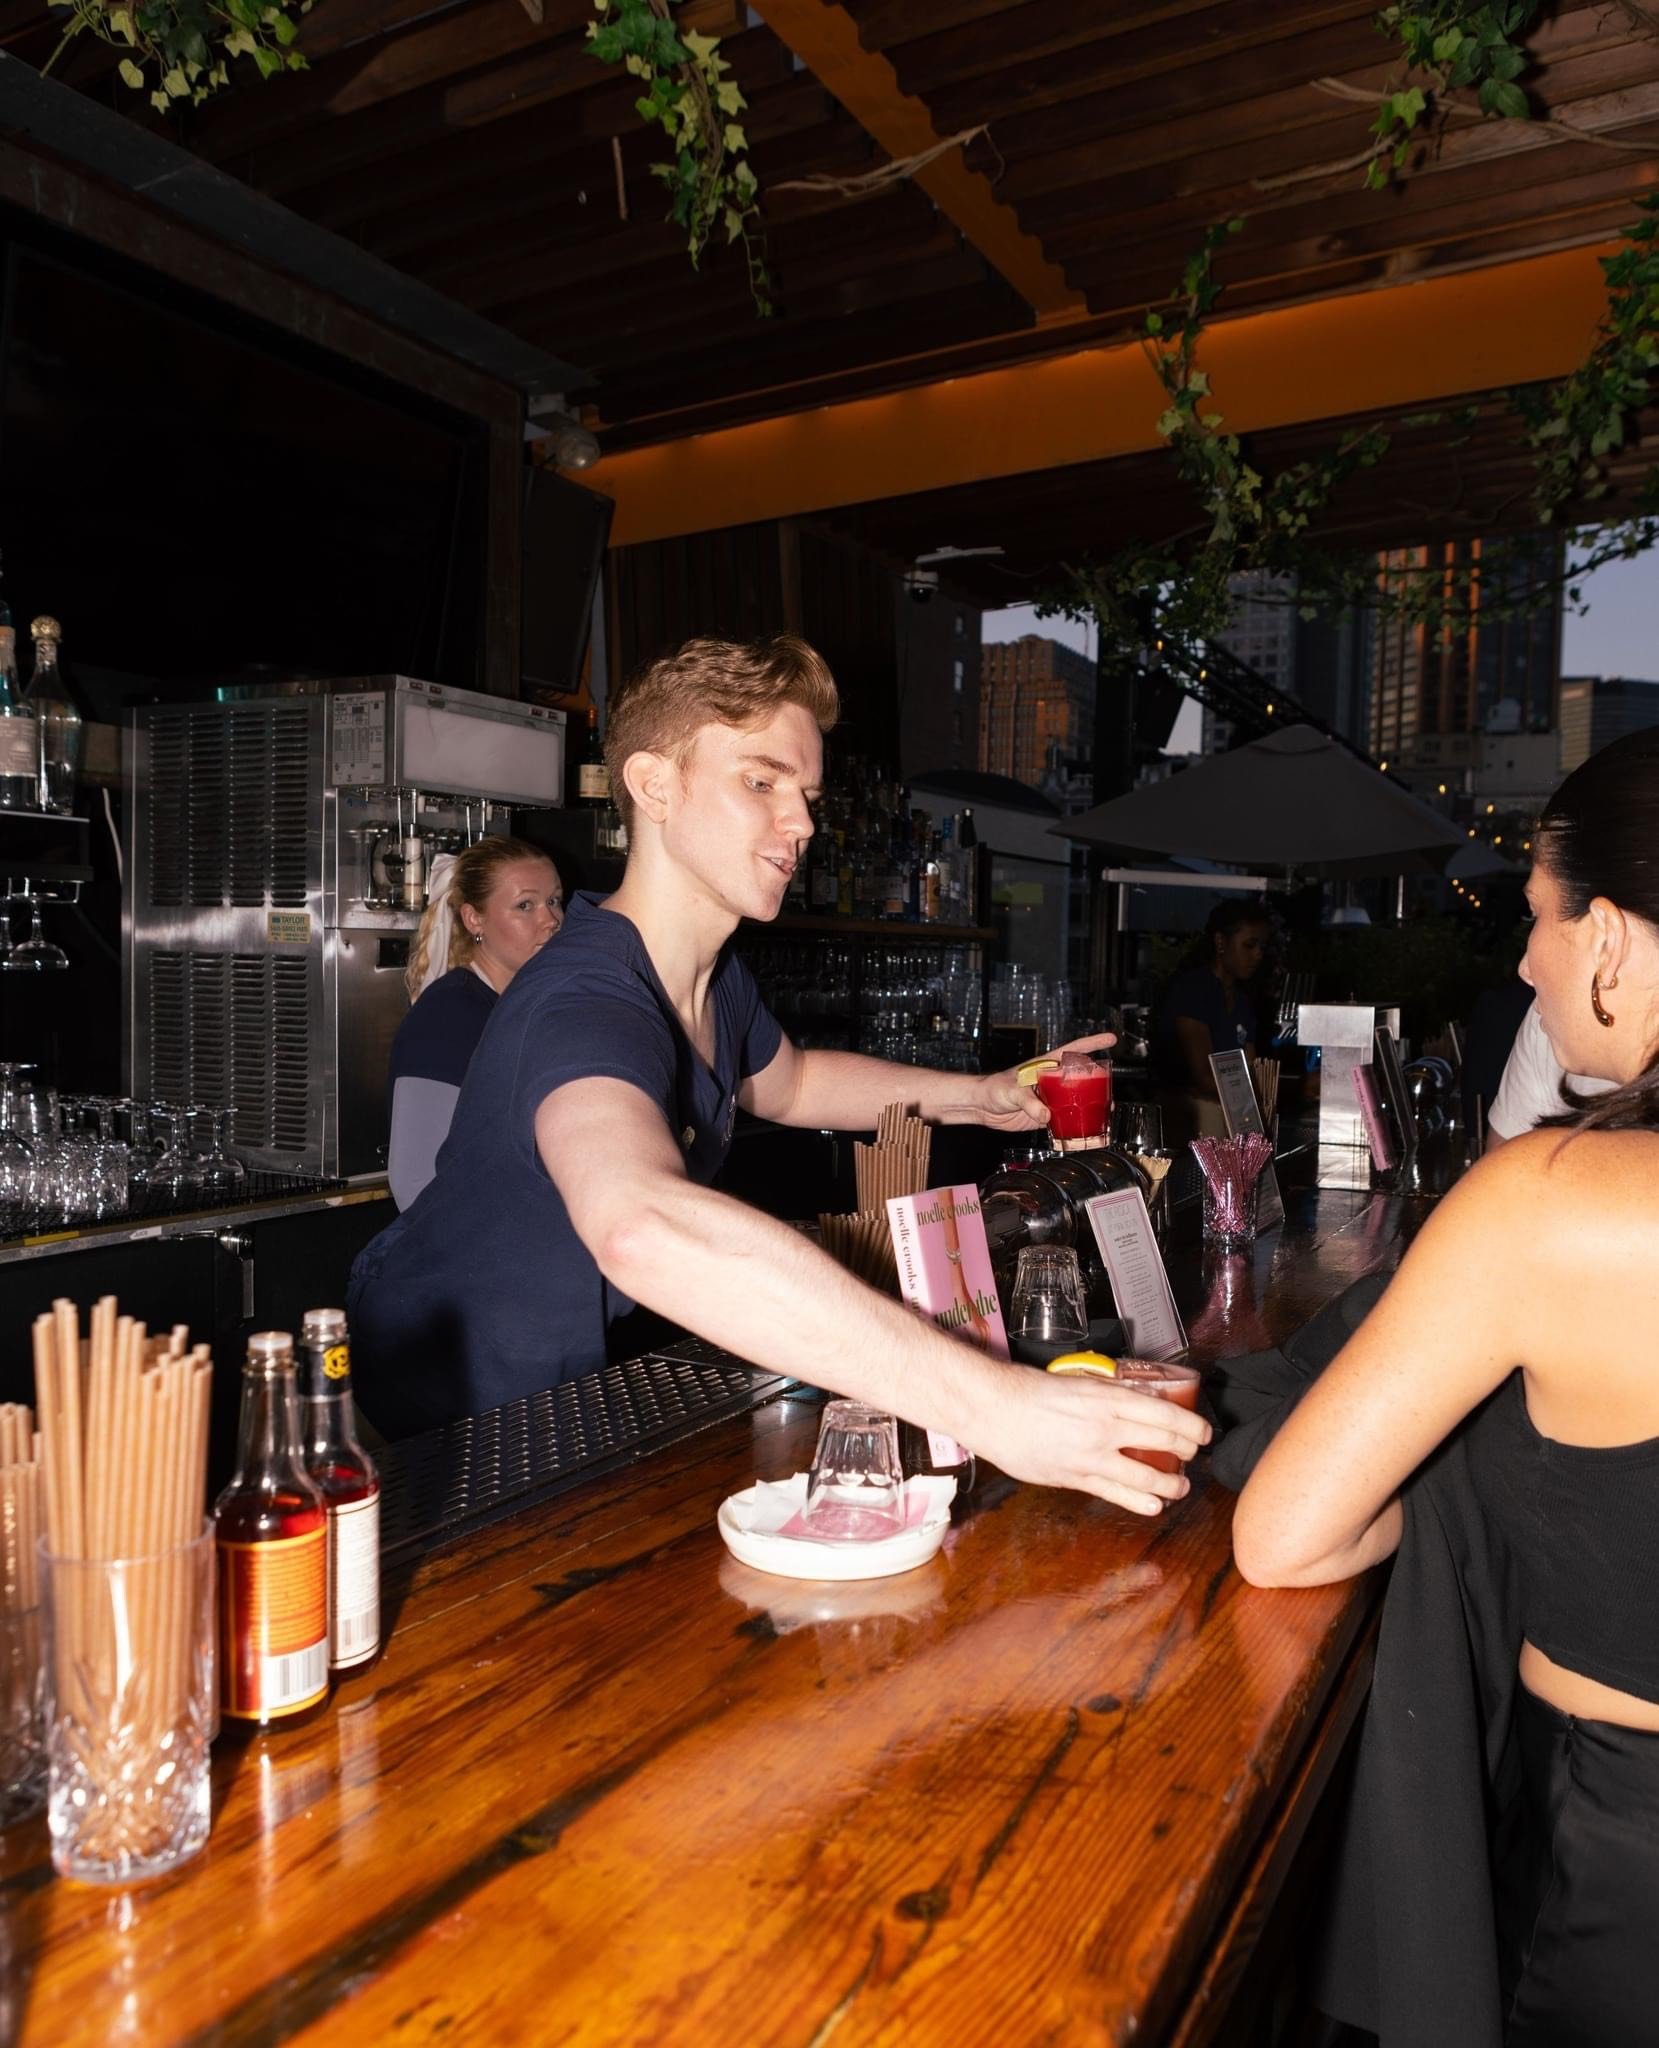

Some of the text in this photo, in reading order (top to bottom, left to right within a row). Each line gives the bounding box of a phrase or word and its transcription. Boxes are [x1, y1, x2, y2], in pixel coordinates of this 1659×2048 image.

[896, 1207, 911, 1244] noelle
[917, 1196, 980, 1226] noelle crooks
[903, 1246, 917, 1290] crooks
[975, 1289, 997, 1317] the
